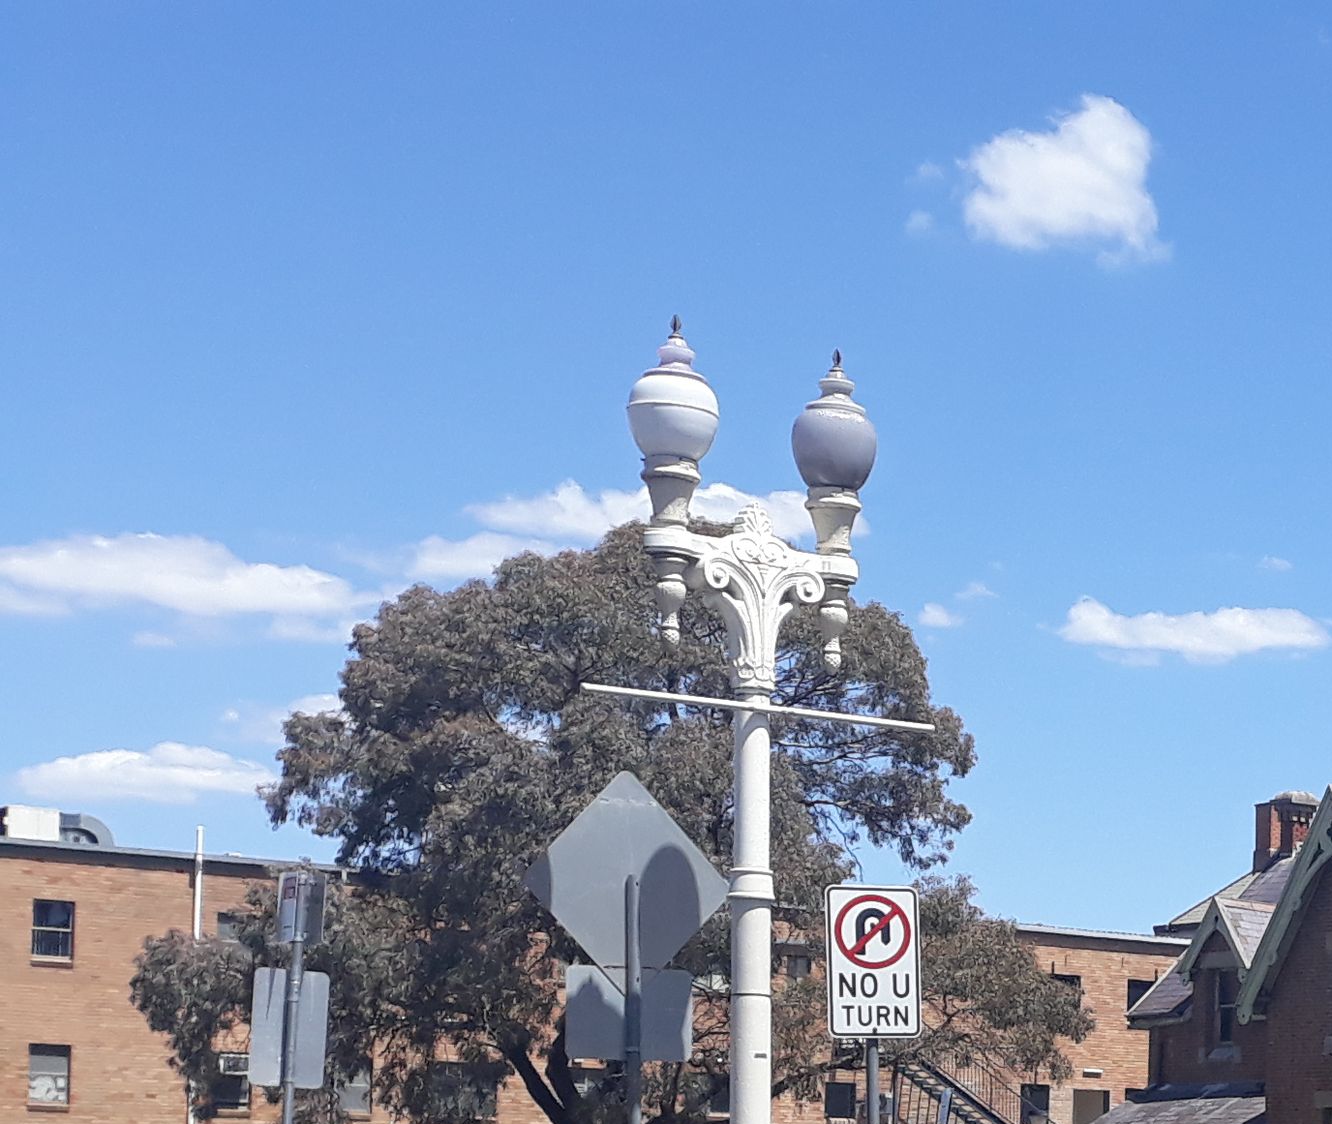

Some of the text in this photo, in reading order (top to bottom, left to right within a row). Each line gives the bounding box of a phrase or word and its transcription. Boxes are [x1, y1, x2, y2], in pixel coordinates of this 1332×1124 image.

[838, 972, 910, 999] NO U
[841, 1005, 909, 1027] TURN
